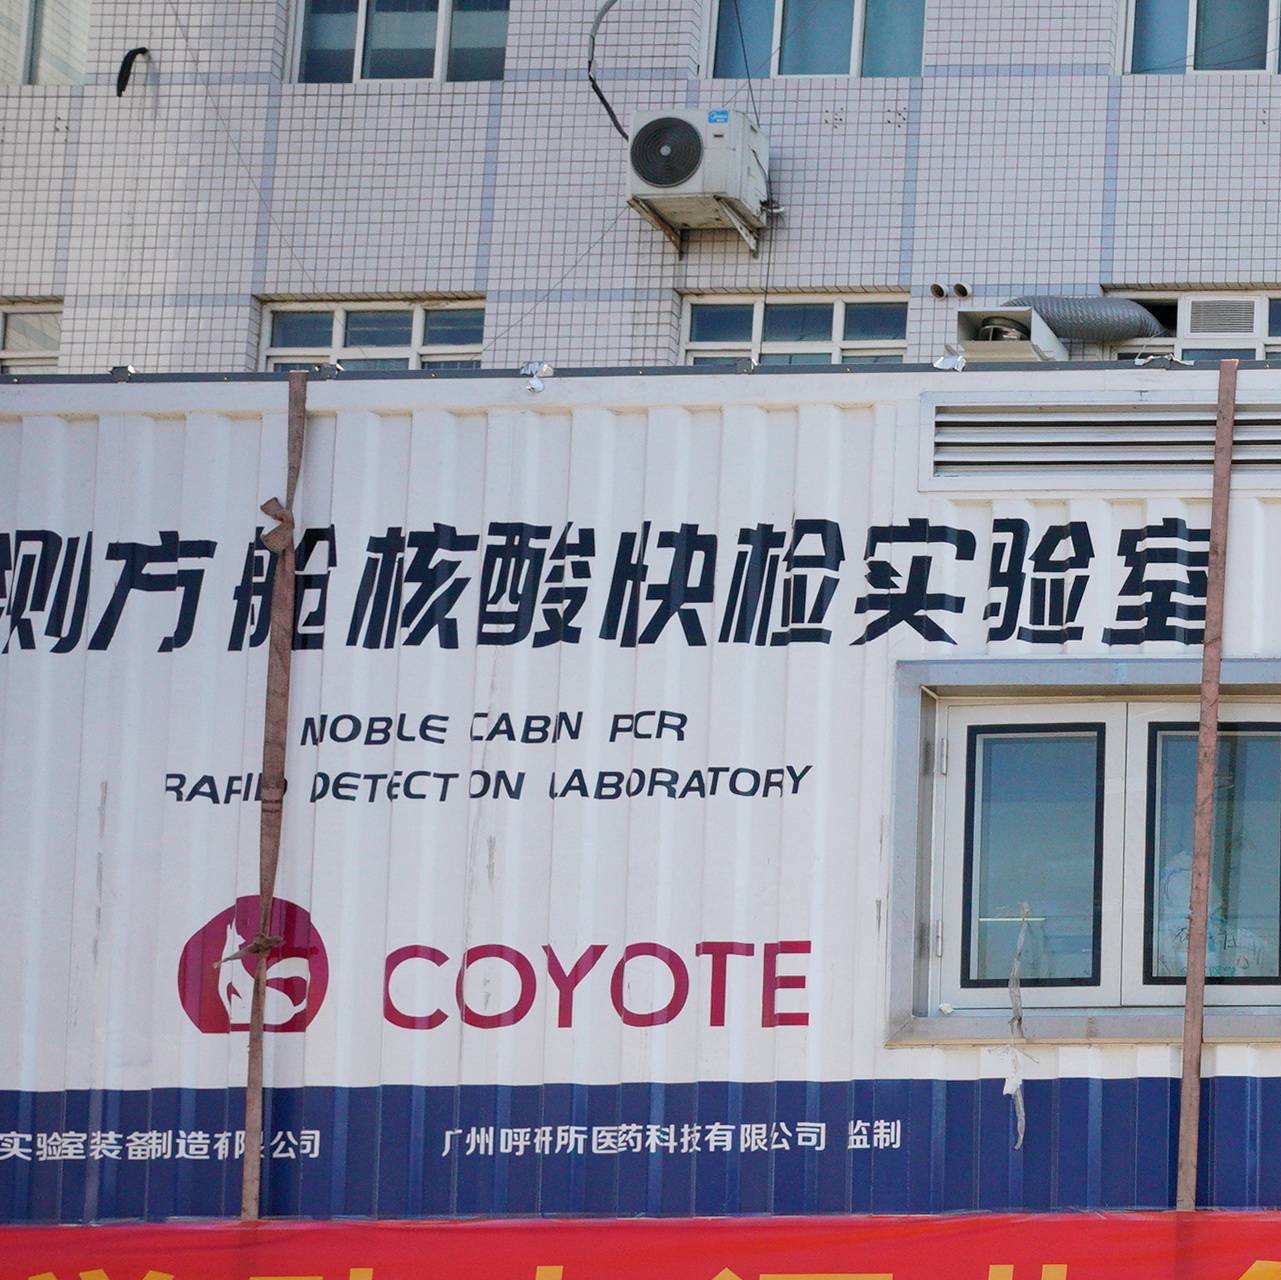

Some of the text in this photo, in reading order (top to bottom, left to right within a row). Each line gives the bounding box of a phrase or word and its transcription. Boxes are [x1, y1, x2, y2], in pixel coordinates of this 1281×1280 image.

[300, 712, 449, 746] NOBLE
[609, 710, 688, 743] PCR
[549, 765, 813, 800] LABORATORY
[384, 941, 812, 1029] COYOTE
[442, 1119, 901, 1157] 广州呼研所医药科技有限公司 监制
